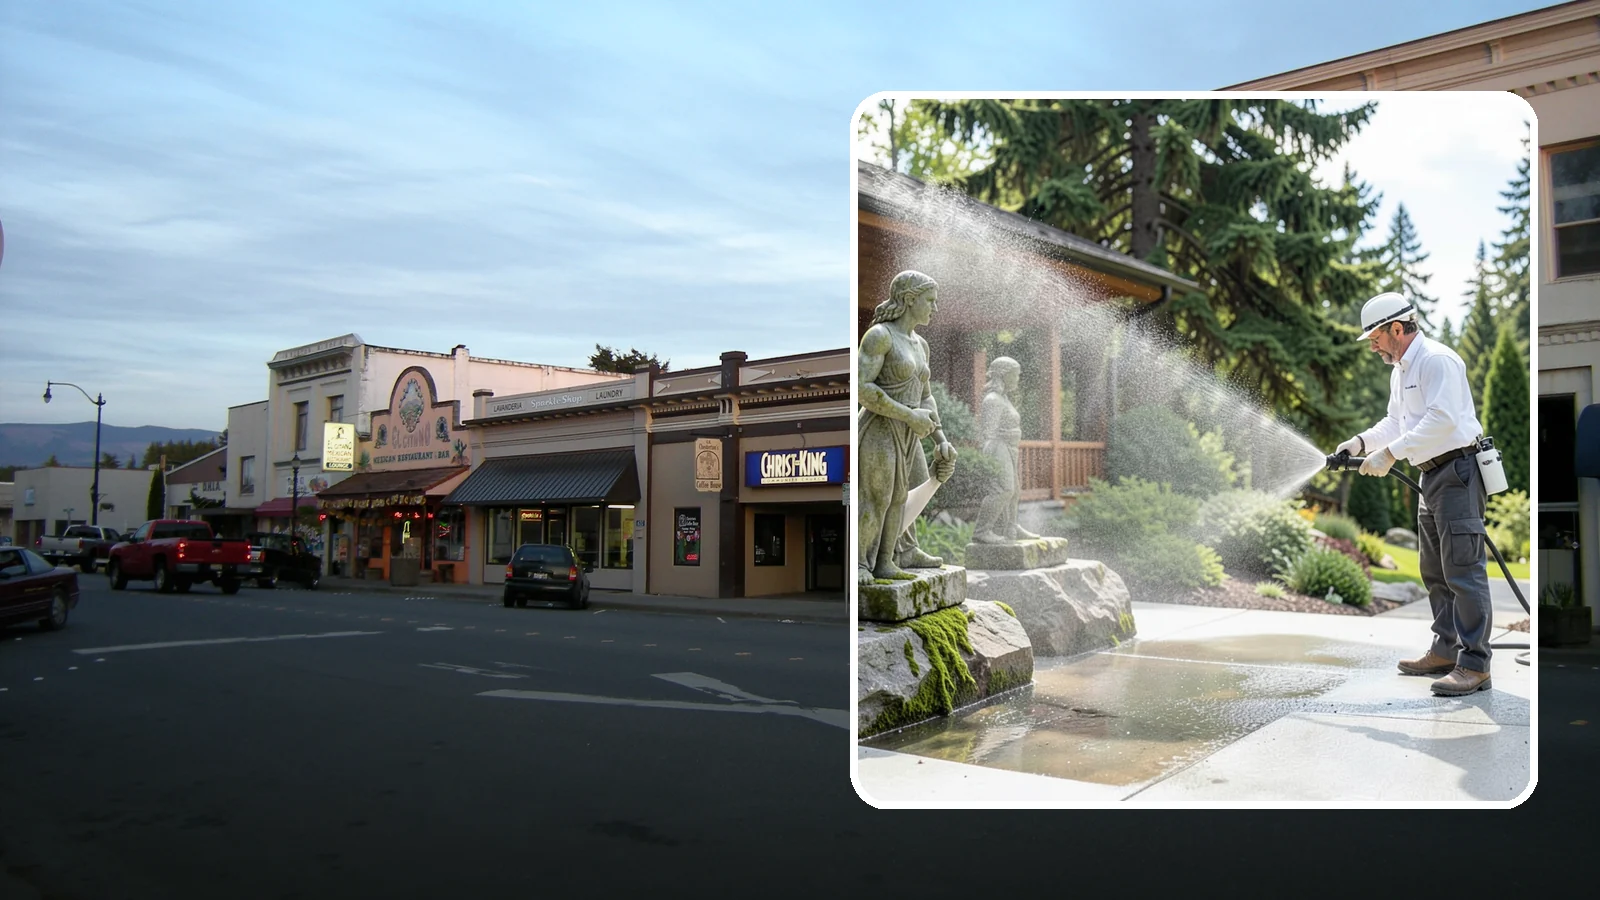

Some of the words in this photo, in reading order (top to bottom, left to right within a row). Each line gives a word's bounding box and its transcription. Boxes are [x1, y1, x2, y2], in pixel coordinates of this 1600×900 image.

[531, 397, 561, 408] Sparkle
[562, 394, 582, 405] Shop
[596, 389, 623, 400] LAUNDRY
[493, 402, 523, 413] LAVANDERIA
[392, 426, 402, 449] EL
[373, 454, 396, 464] MEXICAN
[397, 452, 433, 463] RESTAURANT
[437, 450, 450, 459] BAR
[761, 452, 797, 478] CHRIST
[799, 450, 827, 476] KING
[697, 481, 709, 489] Coffee
